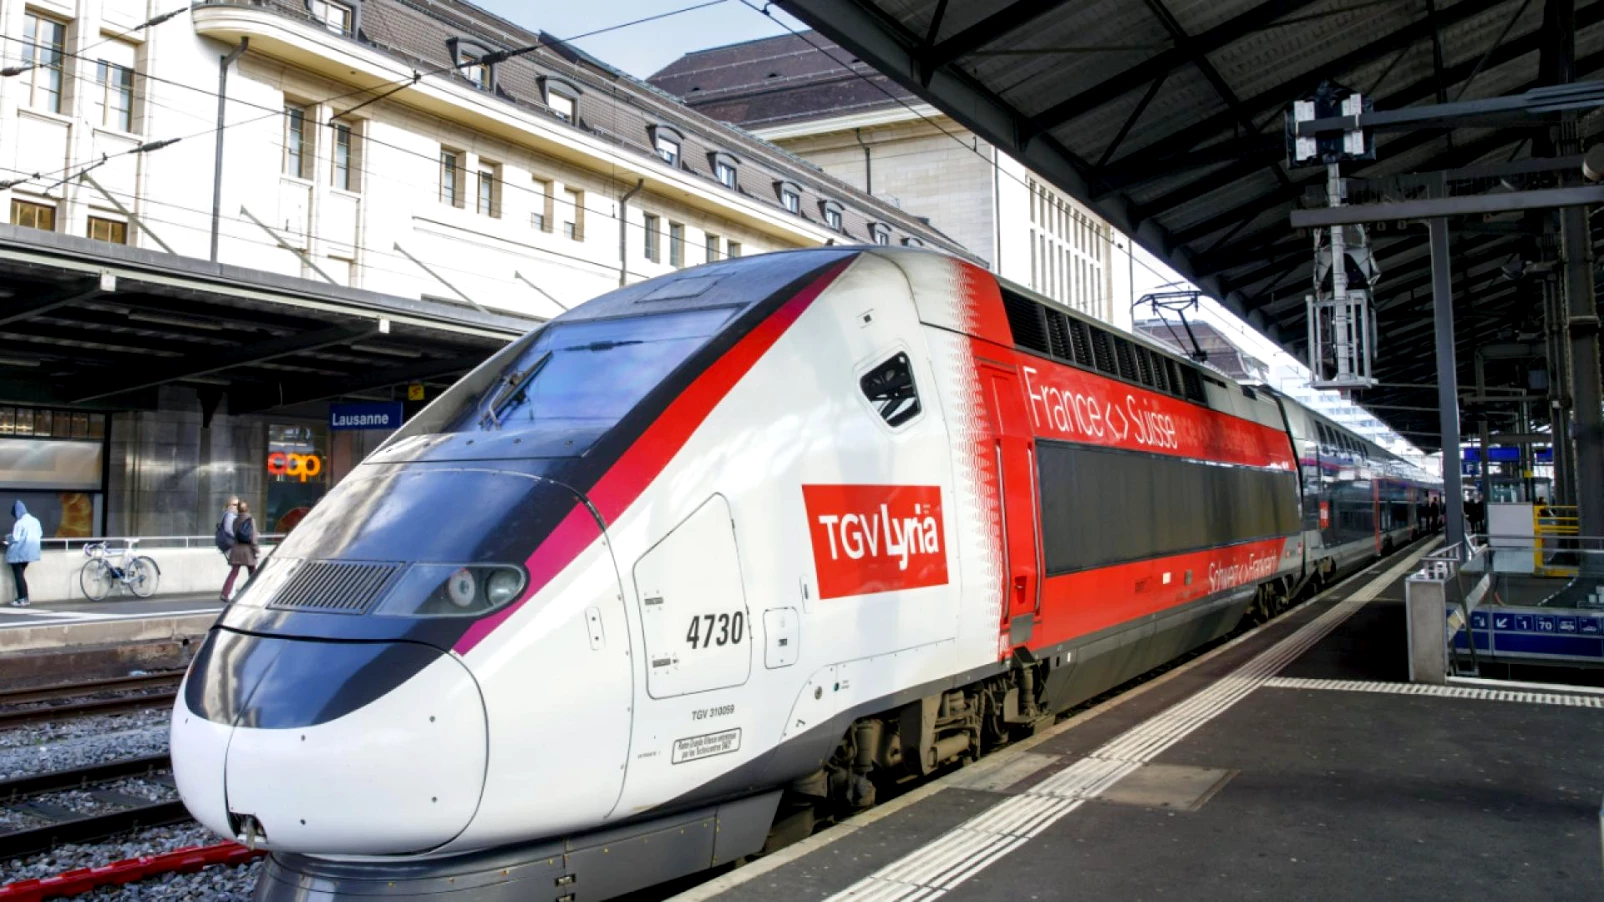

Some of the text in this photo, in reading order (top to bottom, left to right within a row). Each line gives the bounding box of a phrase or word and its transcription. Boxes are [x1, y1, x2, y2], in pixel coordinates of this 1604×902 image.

[1023, 366, 1104, 437] France
[1127, 394, 1178, 450] Suisse
[332, 413, 389, 426] Lausanne
[686, 610, 743, 650] 4730
[1521, 620, 1552, 630] 1 70
[692, 708, 709, 720] TGV
